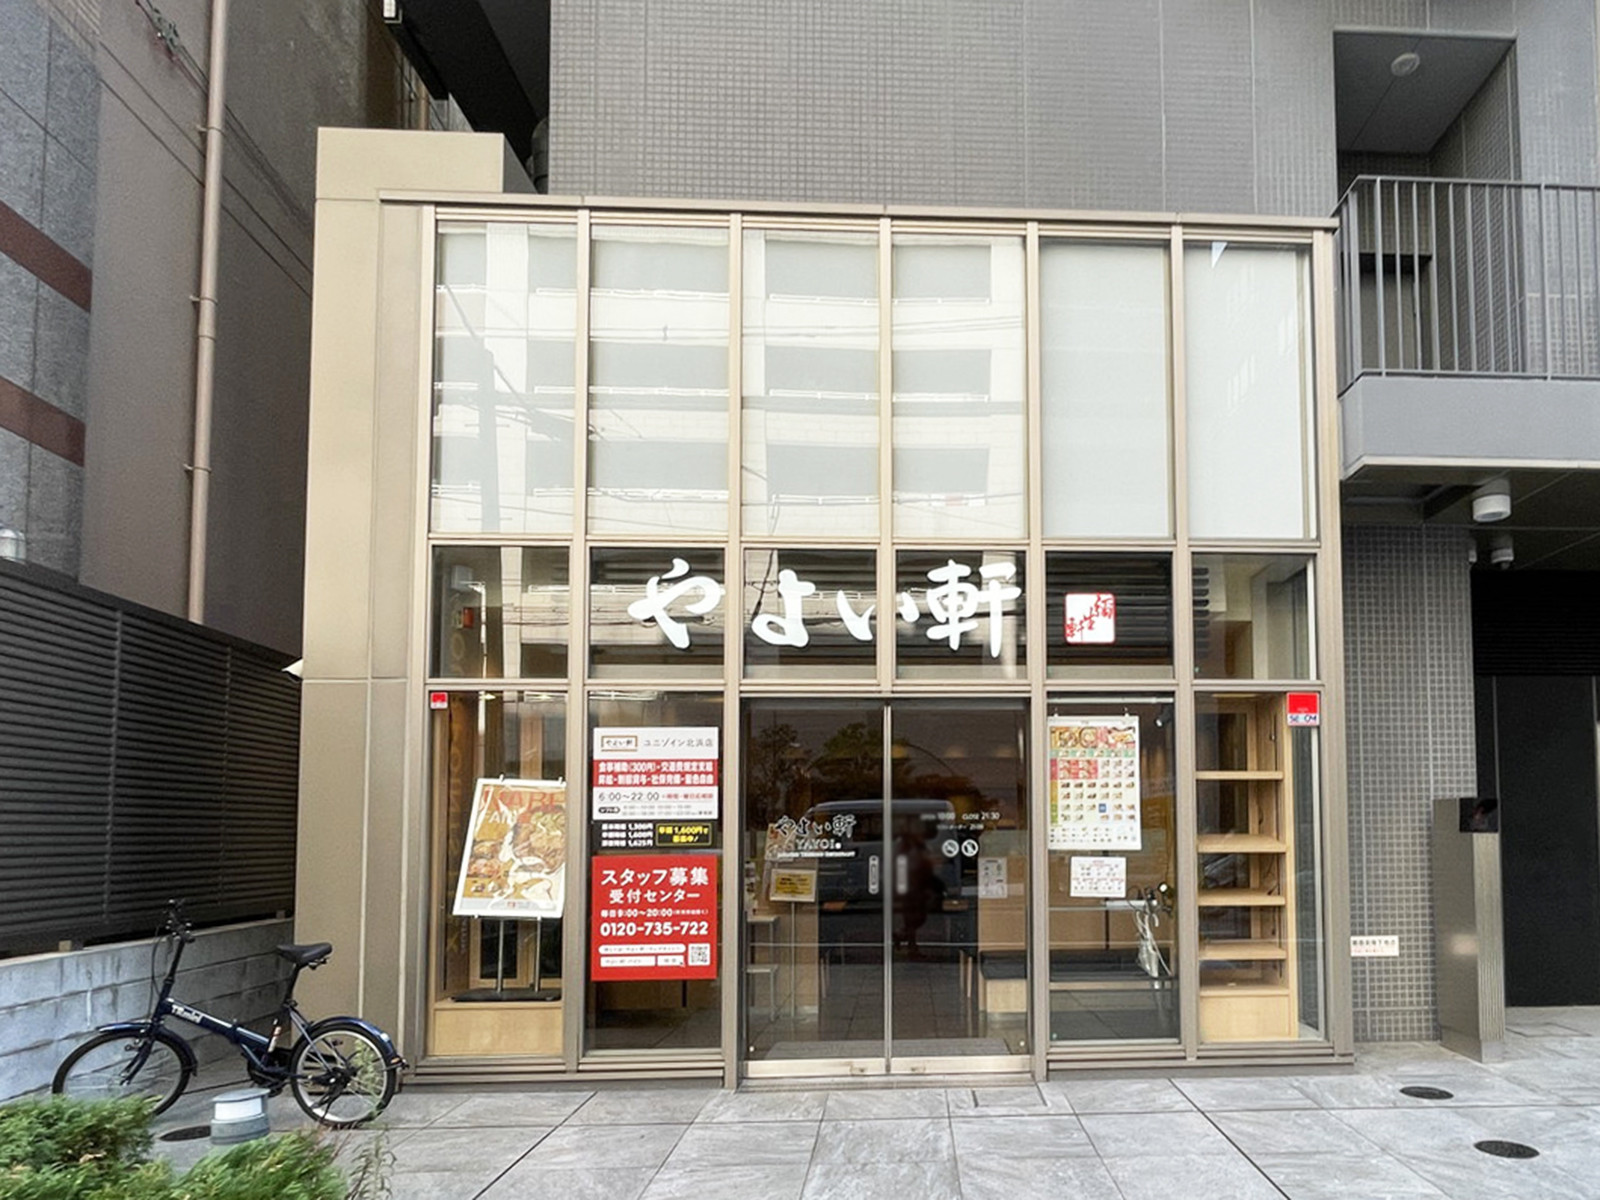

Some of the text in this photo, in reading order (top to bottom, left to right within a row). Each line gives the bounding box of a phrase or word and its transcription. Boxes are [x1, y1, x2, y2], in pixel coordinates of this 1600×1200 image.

[627, 557, 1022, 658] やよい軒
[643, 737, 714, 748] ユニゾイン北浜店
[775, 814, 857, 838] やよい軒
[600, 866, 709, 886] スタッフ募集
[609, 888, 700, 904] 受付センター
[600, 921, 709, 937] 0120-735-722
